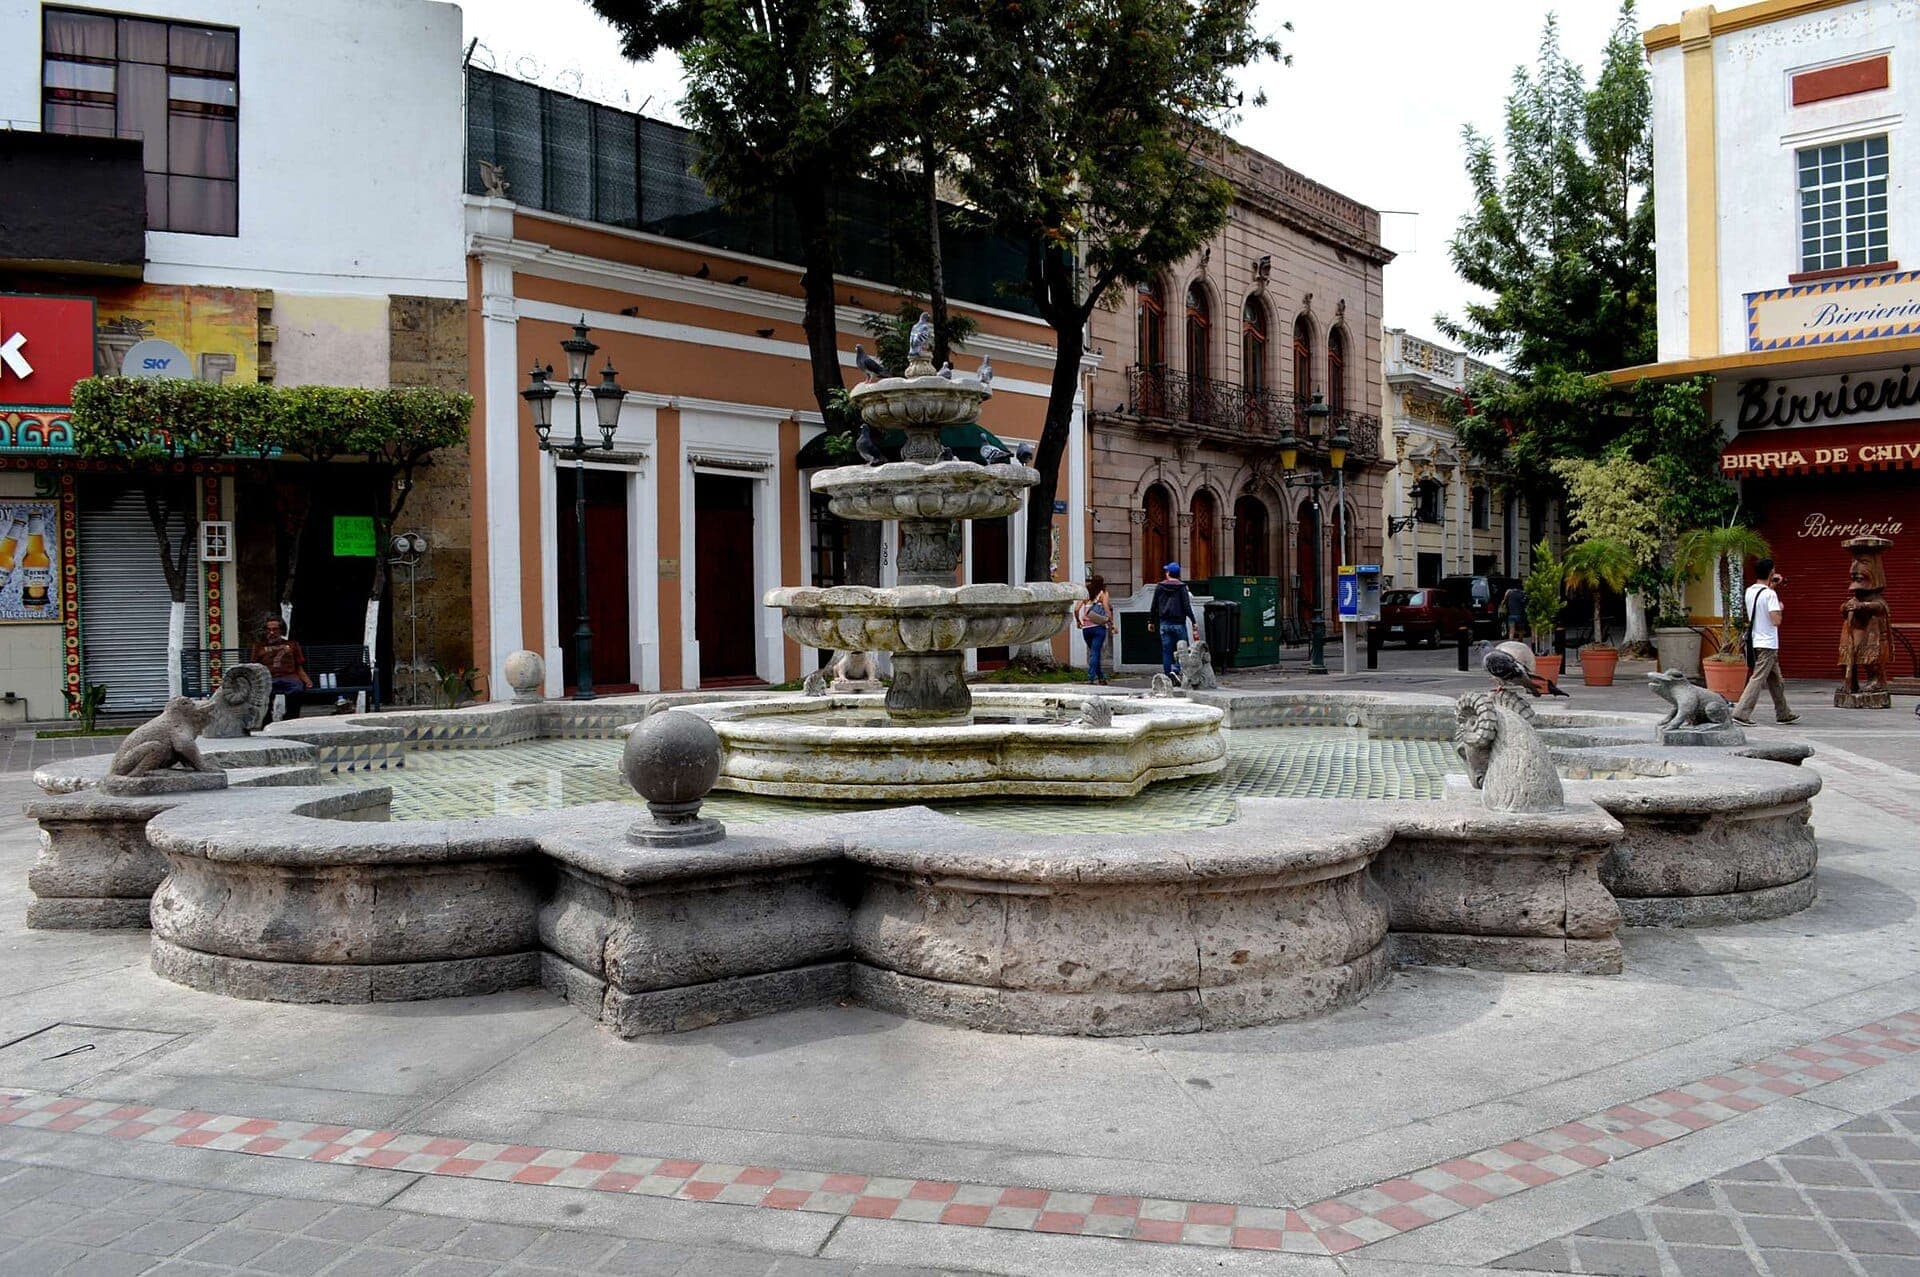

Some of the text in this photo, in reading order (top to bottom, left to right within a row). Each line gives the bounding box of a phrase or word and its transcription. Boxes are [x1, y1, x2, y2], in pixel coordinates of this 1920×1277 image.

[143, 358, 171, 369] SKY
[1722, 450, 1808, 470] BIRRIA
[1815, 448, 1849, 464] DE
